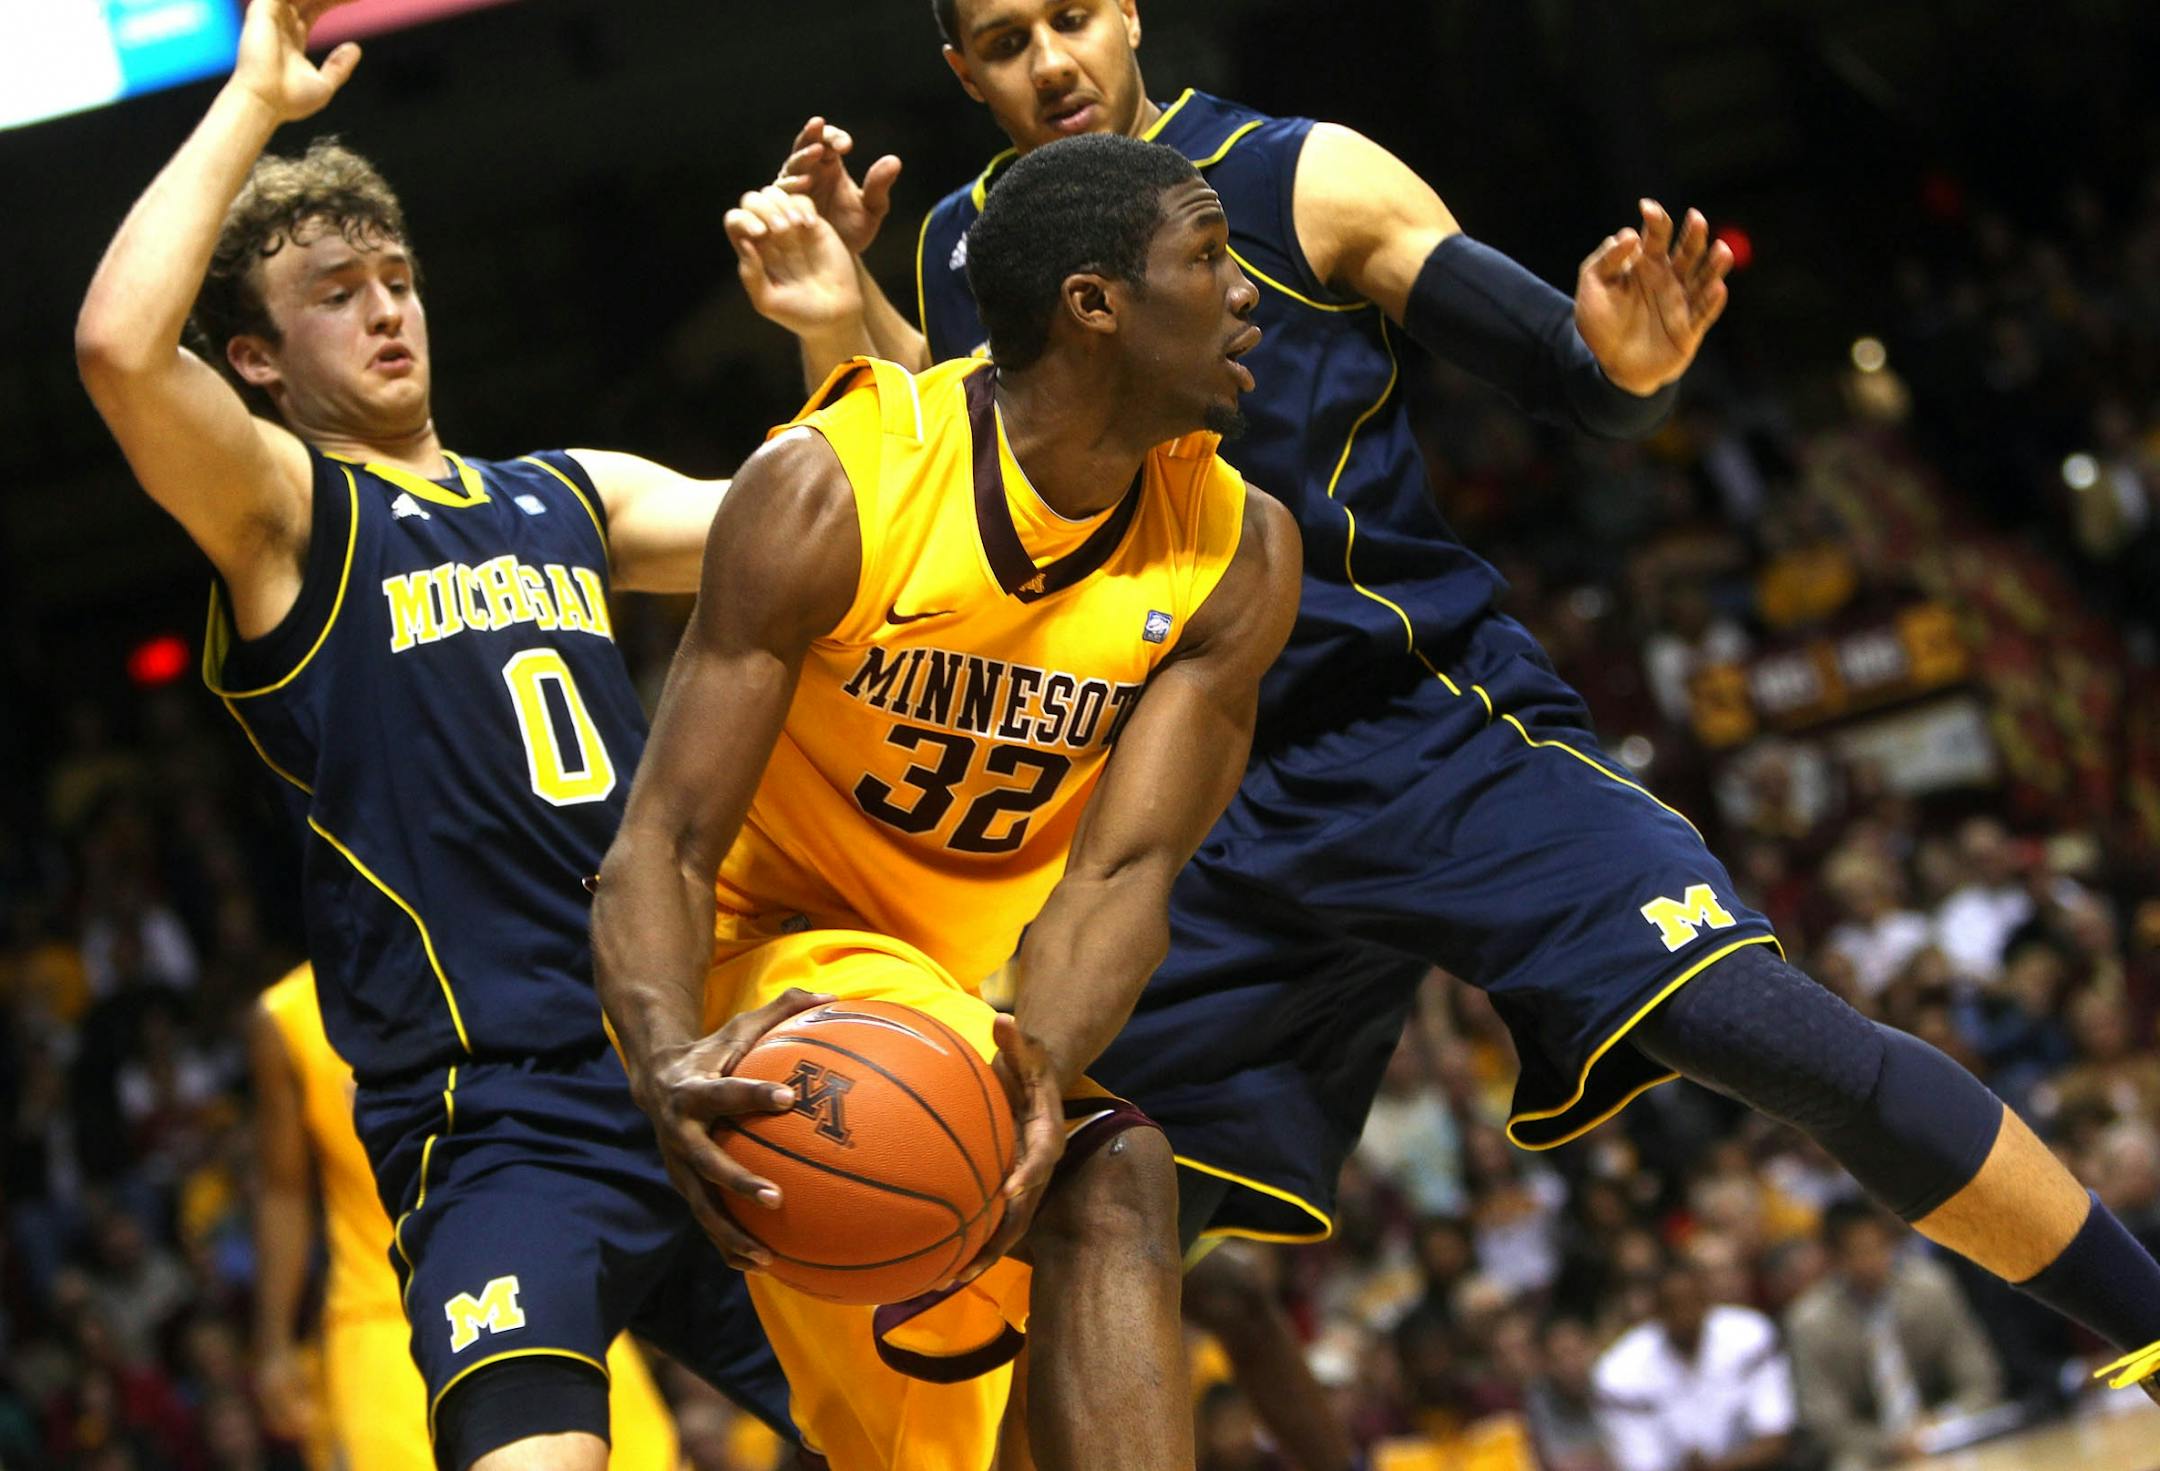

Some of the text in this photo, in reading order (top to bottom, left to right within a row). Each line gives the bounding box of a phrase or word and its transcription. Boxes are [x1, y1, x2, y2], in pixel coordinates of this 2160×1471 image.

[382, 555, 614, 653] MICHGAN
[502, 648, 616, 806] 0
[853, 723, 1072, 854] 32
[1640, 883, 1737, 952] M
[784, 1059, 855, 1145] M
[444, 1274, 526, 1353] M
